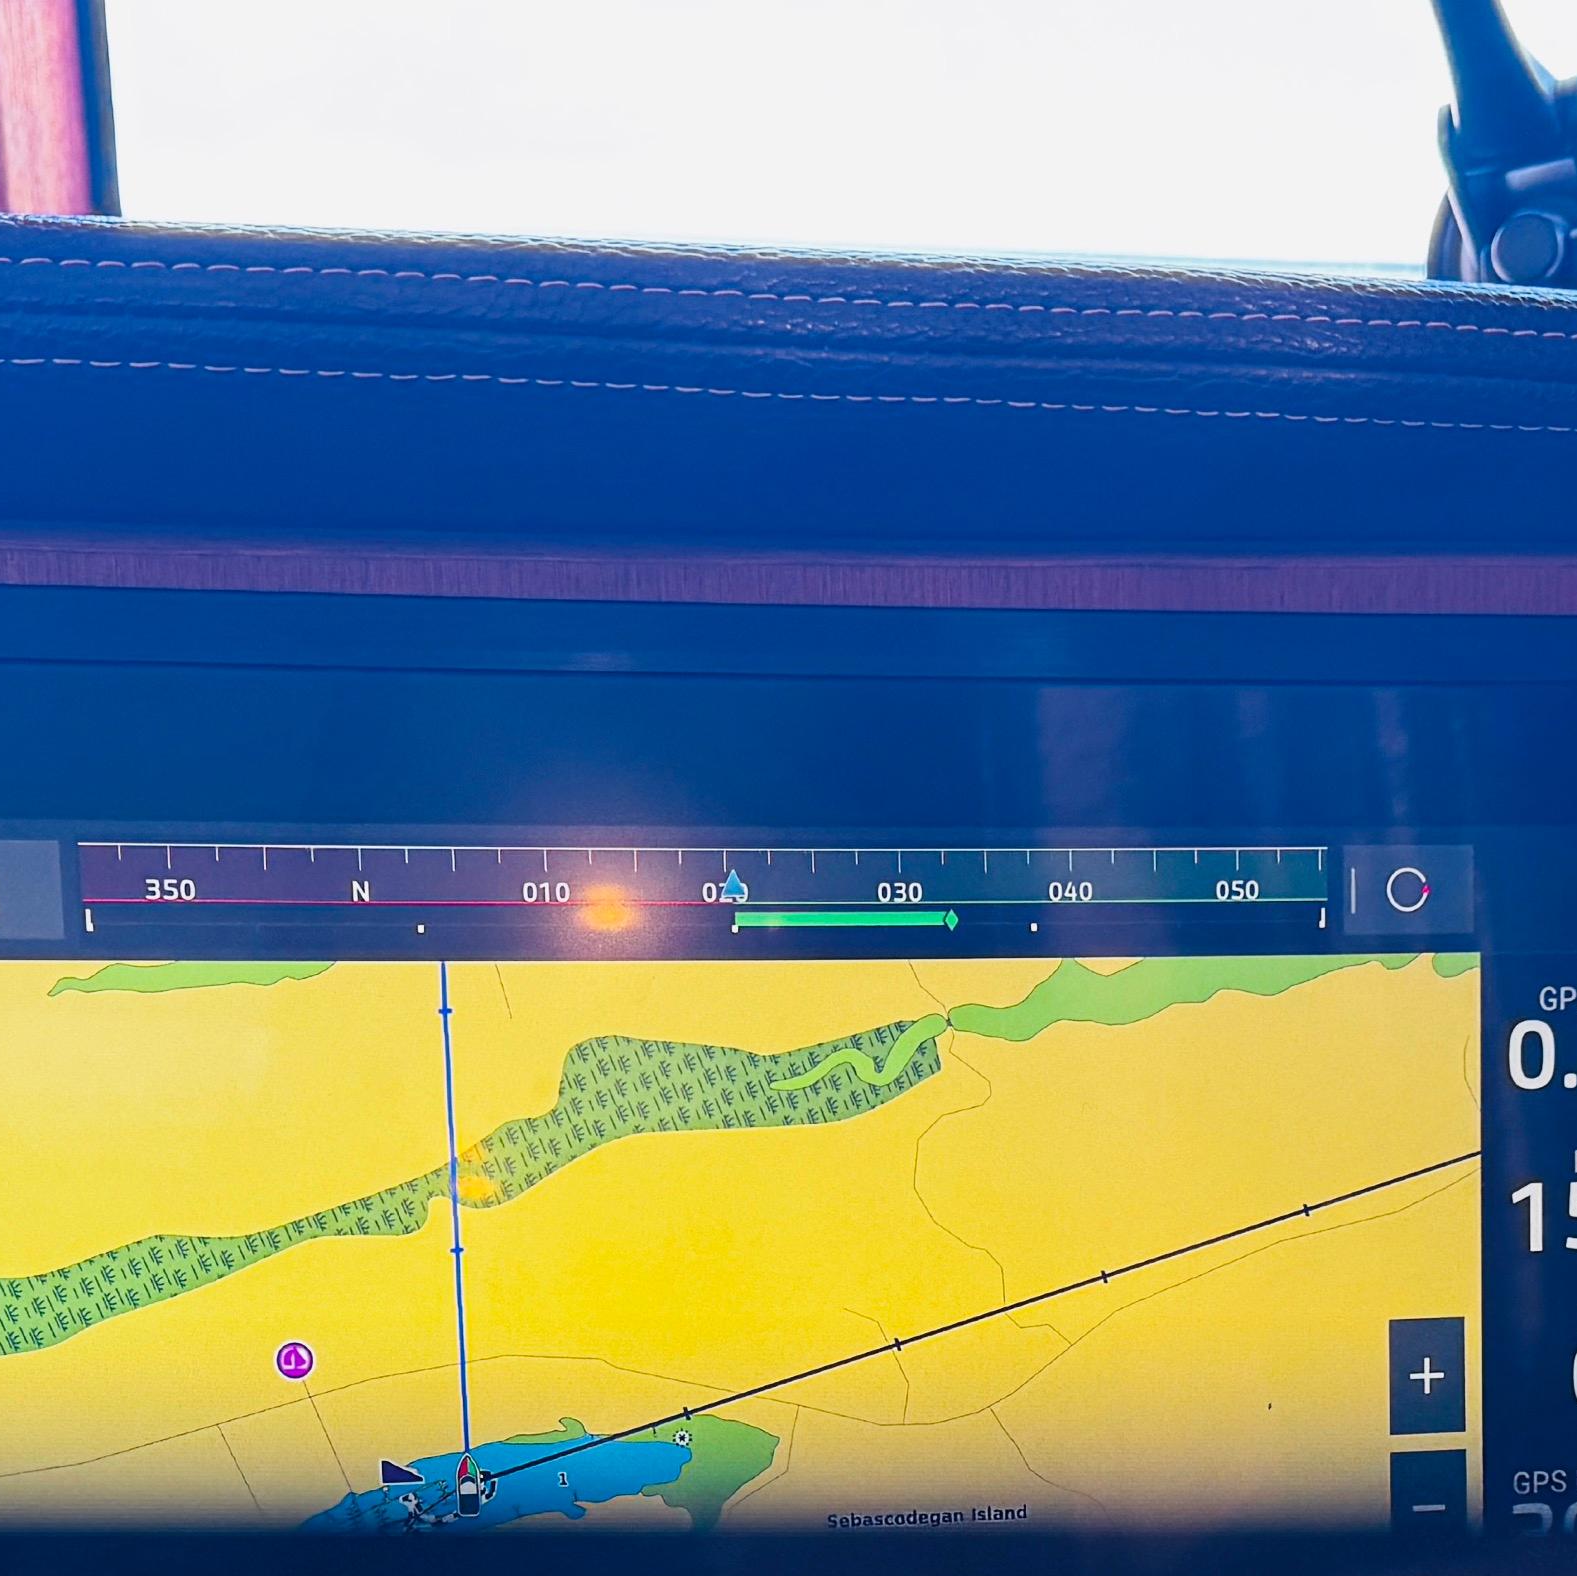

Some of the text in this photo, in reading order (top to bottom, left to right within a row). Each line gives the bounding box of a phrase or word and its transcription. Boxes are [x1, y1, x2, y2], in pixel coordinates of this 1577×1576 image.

[145, 879, 196, 901] 350
[352, 881, 370, 902] N
[522, 881, 571, 903] 010
[876, 882, 923, 903] 030
[1049, 881, 1094, 902] 040
[1215, 880, 1260, 901] 050
[1513, 1470, 1567, 1495] GPS
[826, 1504, 1028, 1530] Sebascodegan Island
